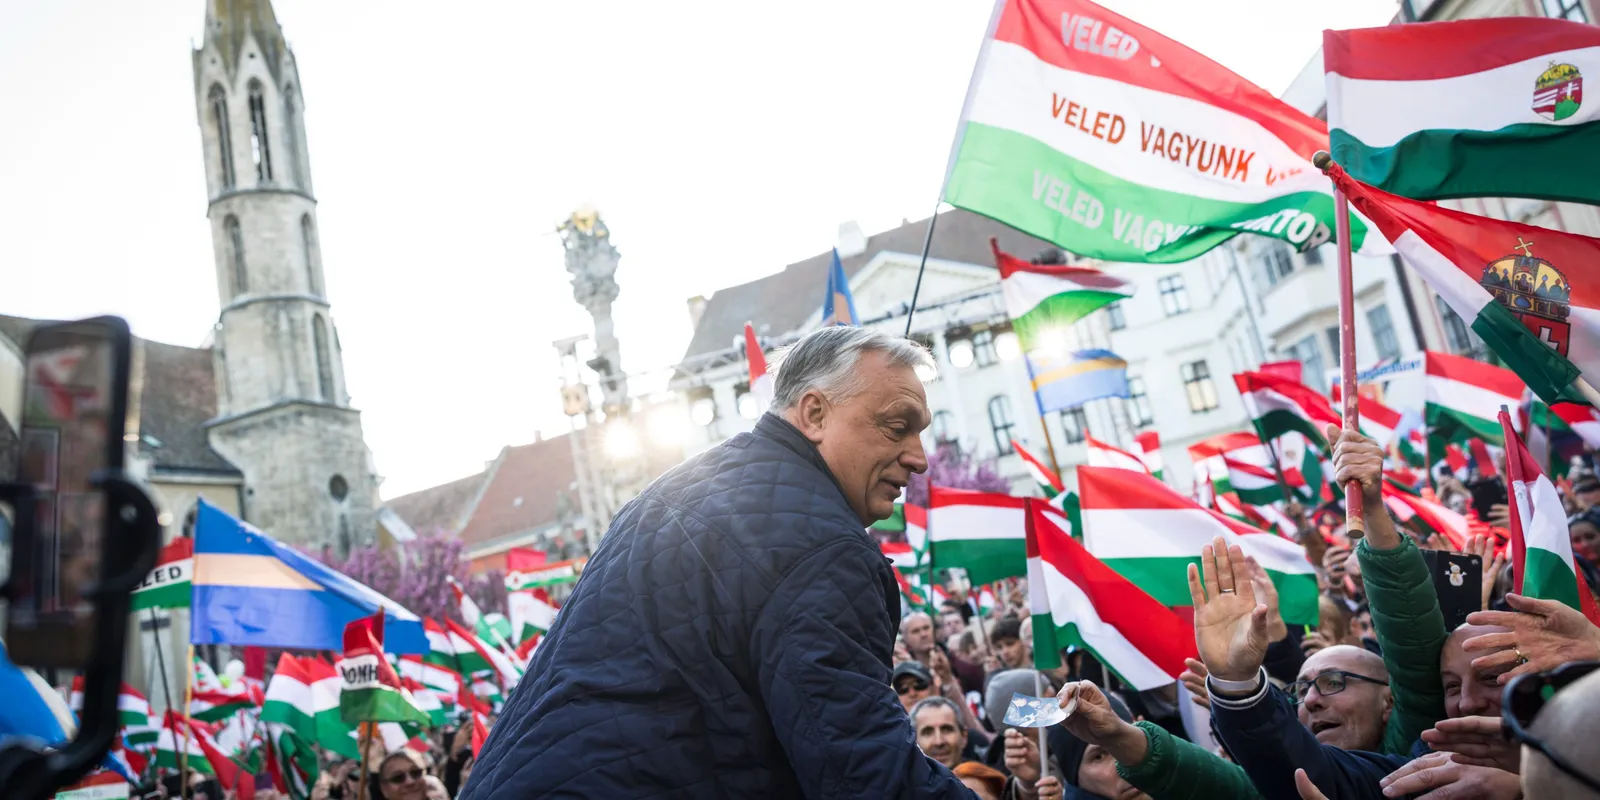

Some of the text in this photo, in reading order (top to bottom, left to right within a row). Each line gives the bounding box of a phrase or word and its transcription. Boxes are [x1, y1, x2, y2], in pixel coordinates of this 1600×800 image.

[1061, 11, 1141, 61] VELED
[1051, 92, 1126, 145] VELED
[1140, 120, 1256, 183] VAGYUNK
[1031, 168, 1105, 230] VELED
[131, 565, 182, 590] LED
